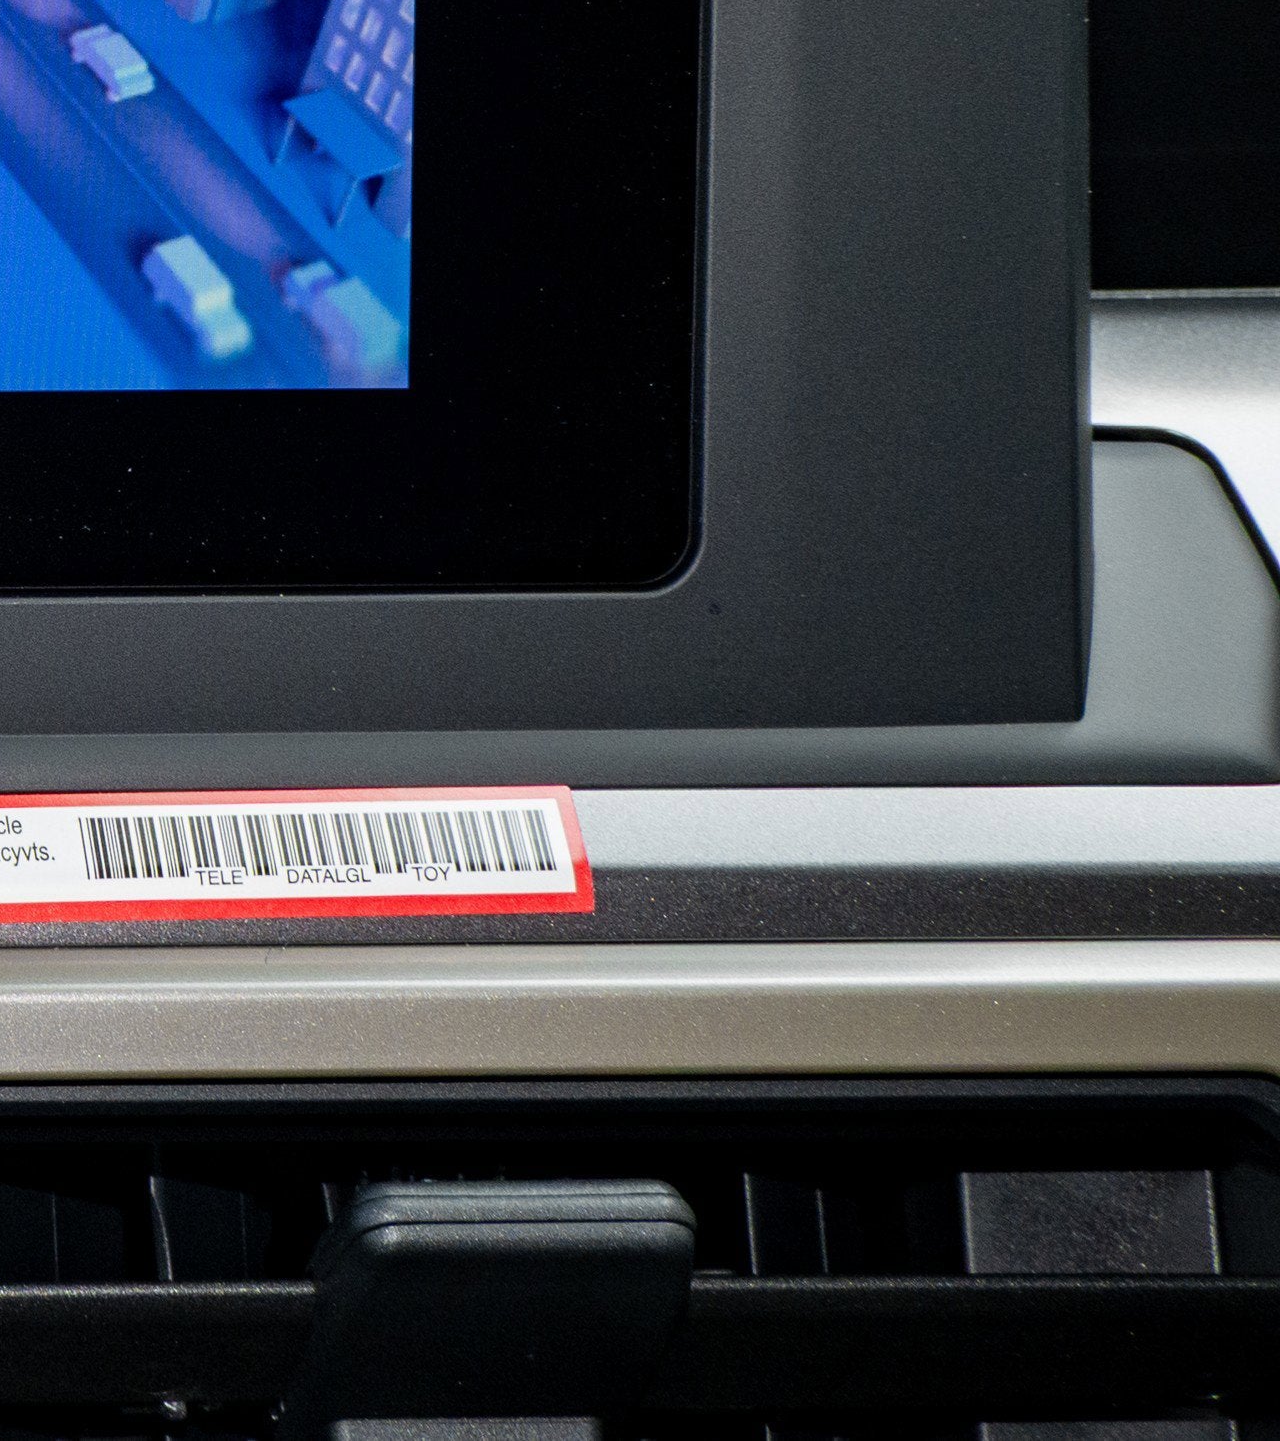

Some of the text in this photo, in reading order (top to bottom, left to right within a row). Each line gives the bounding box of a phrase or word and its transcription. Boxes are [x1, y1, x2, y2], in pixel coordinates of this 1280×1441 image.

[195, 866, 452, 886] TELE DATALGL TOY
